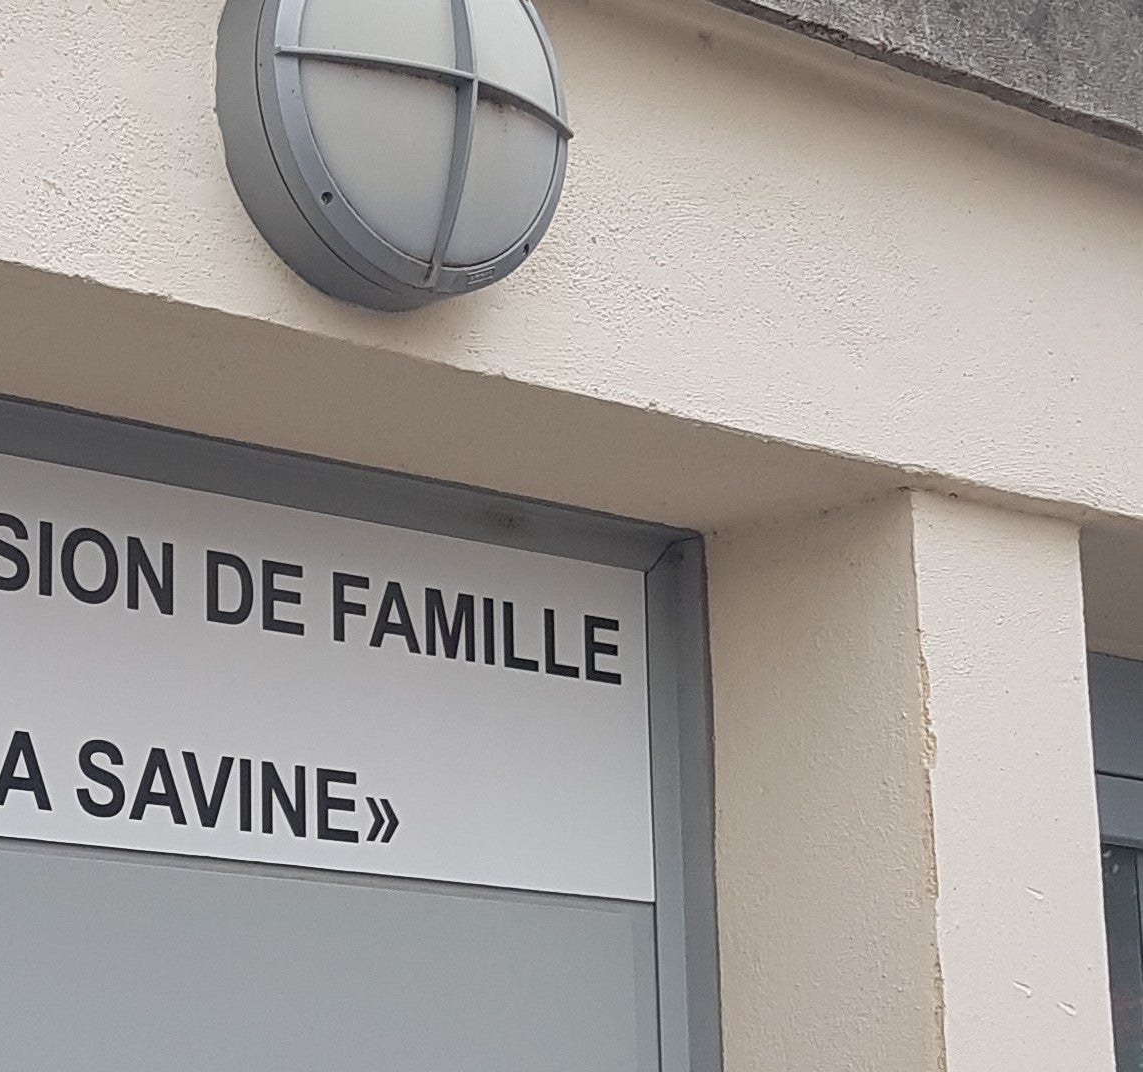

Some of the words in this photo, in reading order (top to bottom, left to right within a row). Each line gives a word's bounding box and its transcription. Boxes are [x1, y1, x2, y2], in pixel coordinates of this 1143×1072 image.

[206, 550, 305, 636] DE
[333, 571, 622, 685] FAMILLE
[76, 739, 400, 843] SAVINE»
